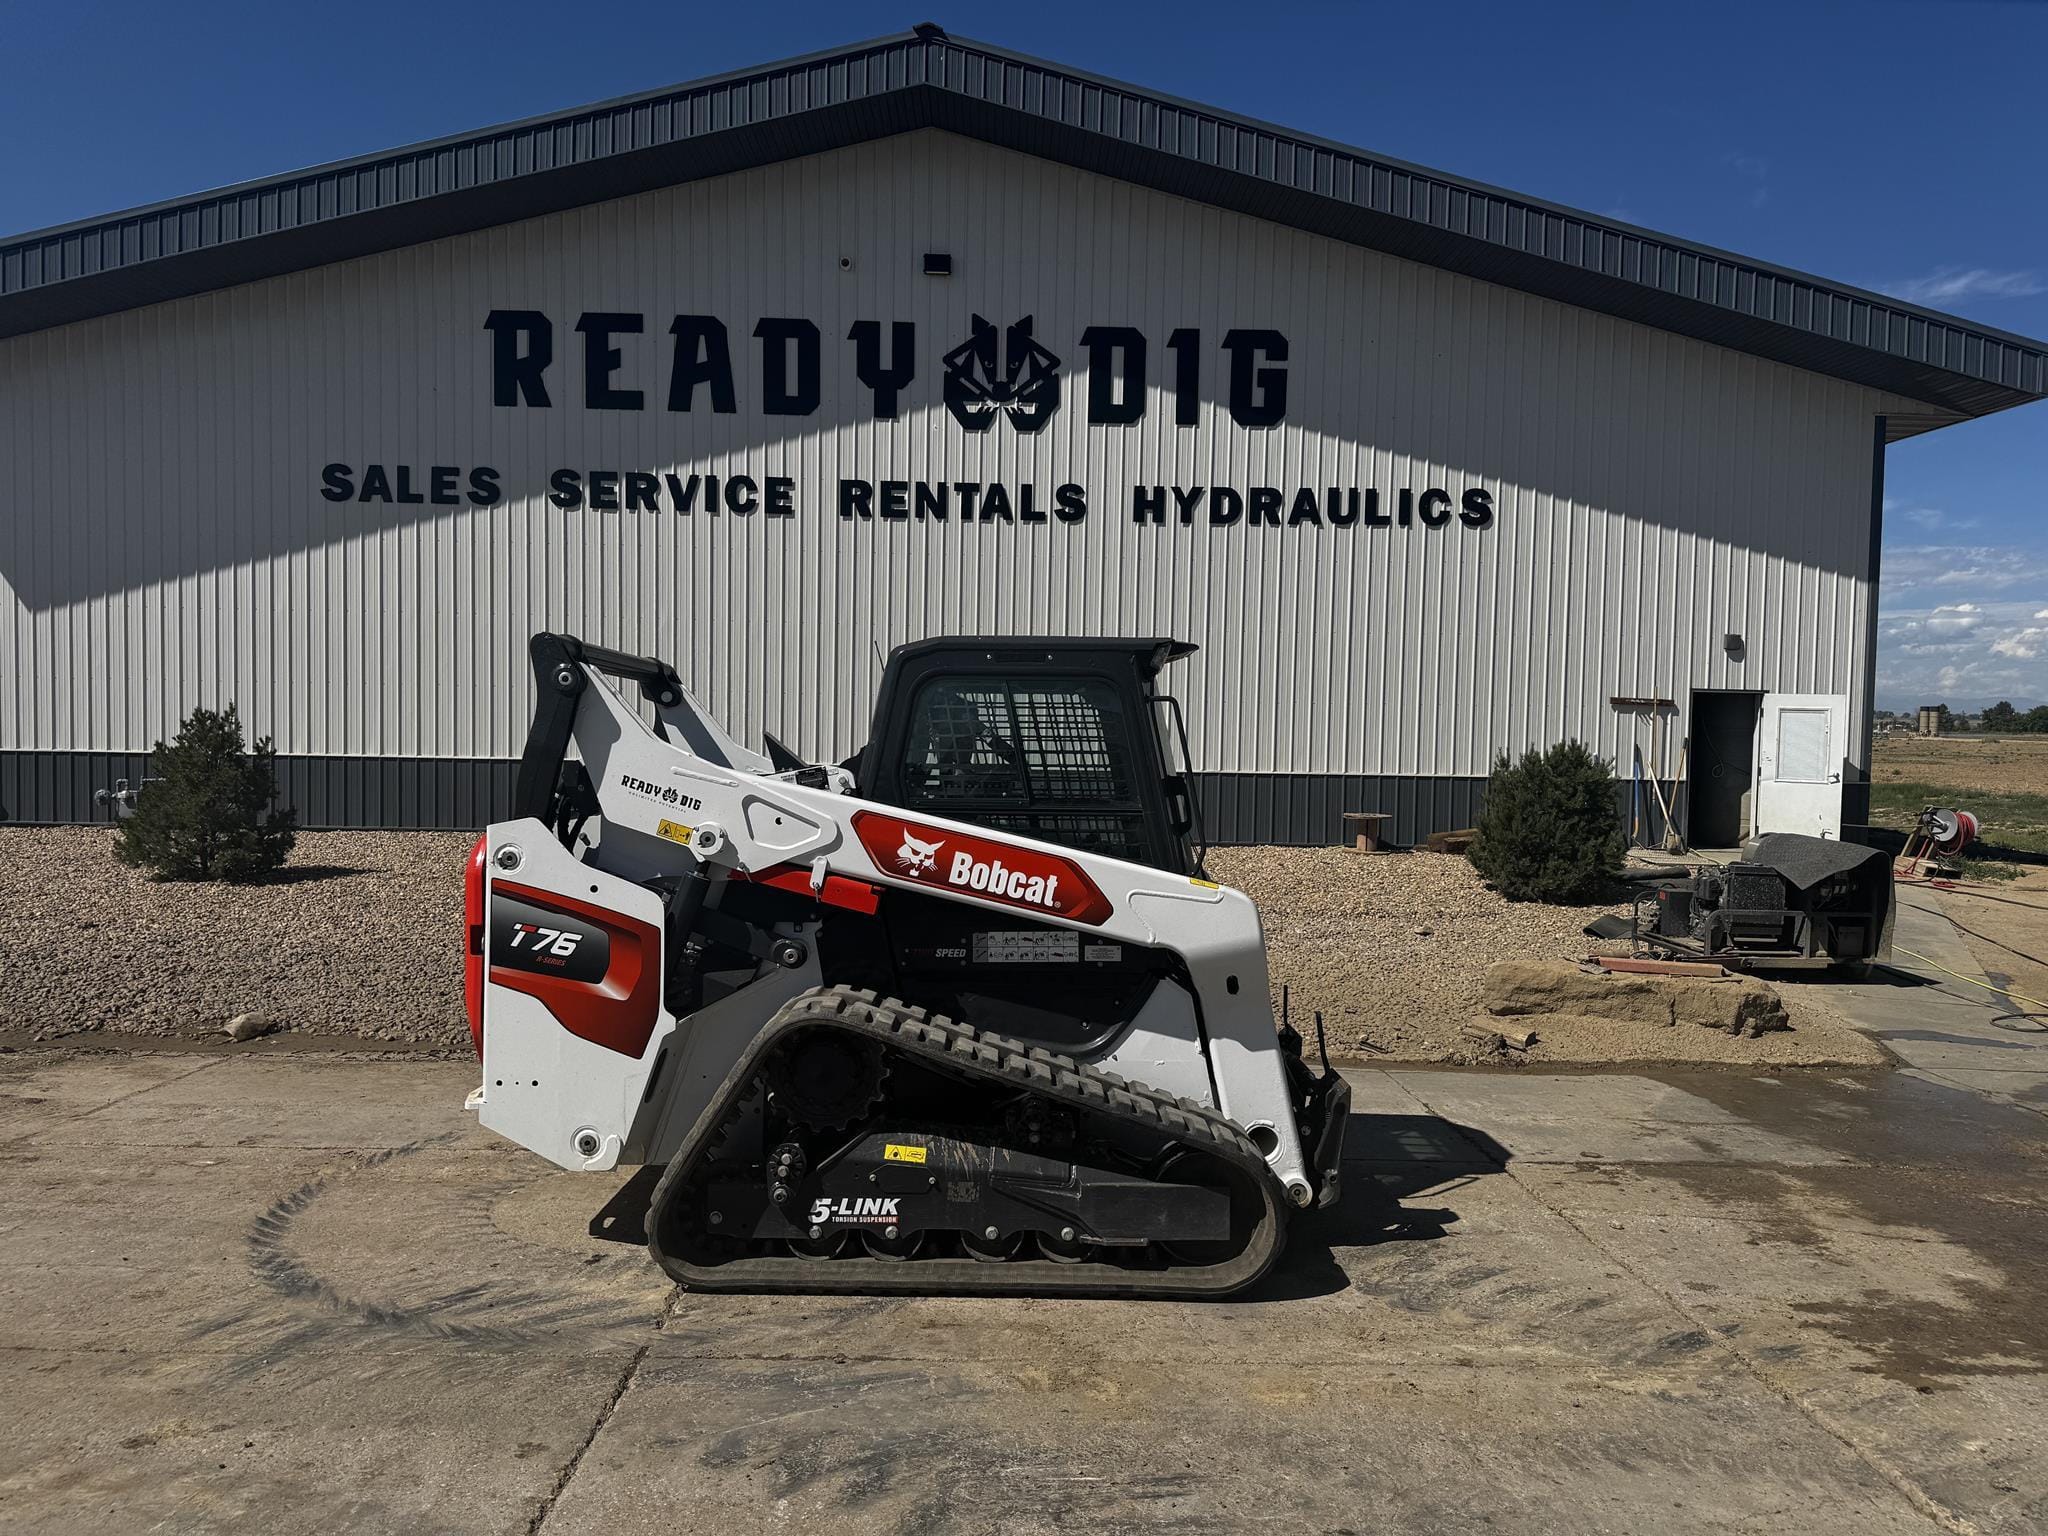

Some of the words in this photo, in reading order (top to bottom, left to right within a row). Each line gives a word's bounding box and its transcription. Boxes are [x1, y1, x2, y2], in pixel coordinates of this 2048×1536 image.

[484, 310, 916, 419] READY
[1079, 326, 1289, 426] DIG
[320, 463, 501, 505] SALES
[549, 468, 795, 515] SERVICE
[840, 479, 1087, 522] RENTALS
[1133, 486, 1494, 527] HYDRAULICS
[621, 774, 662, 797] READY
[680, 794, 702, 811] DIG
[510, 923, 584, 957] T76
[935, 948, 967, 958] SPEED
[535, 955, 567, 967] R-SERIES
[808, 1198, 902, 1224] 5-LINK
